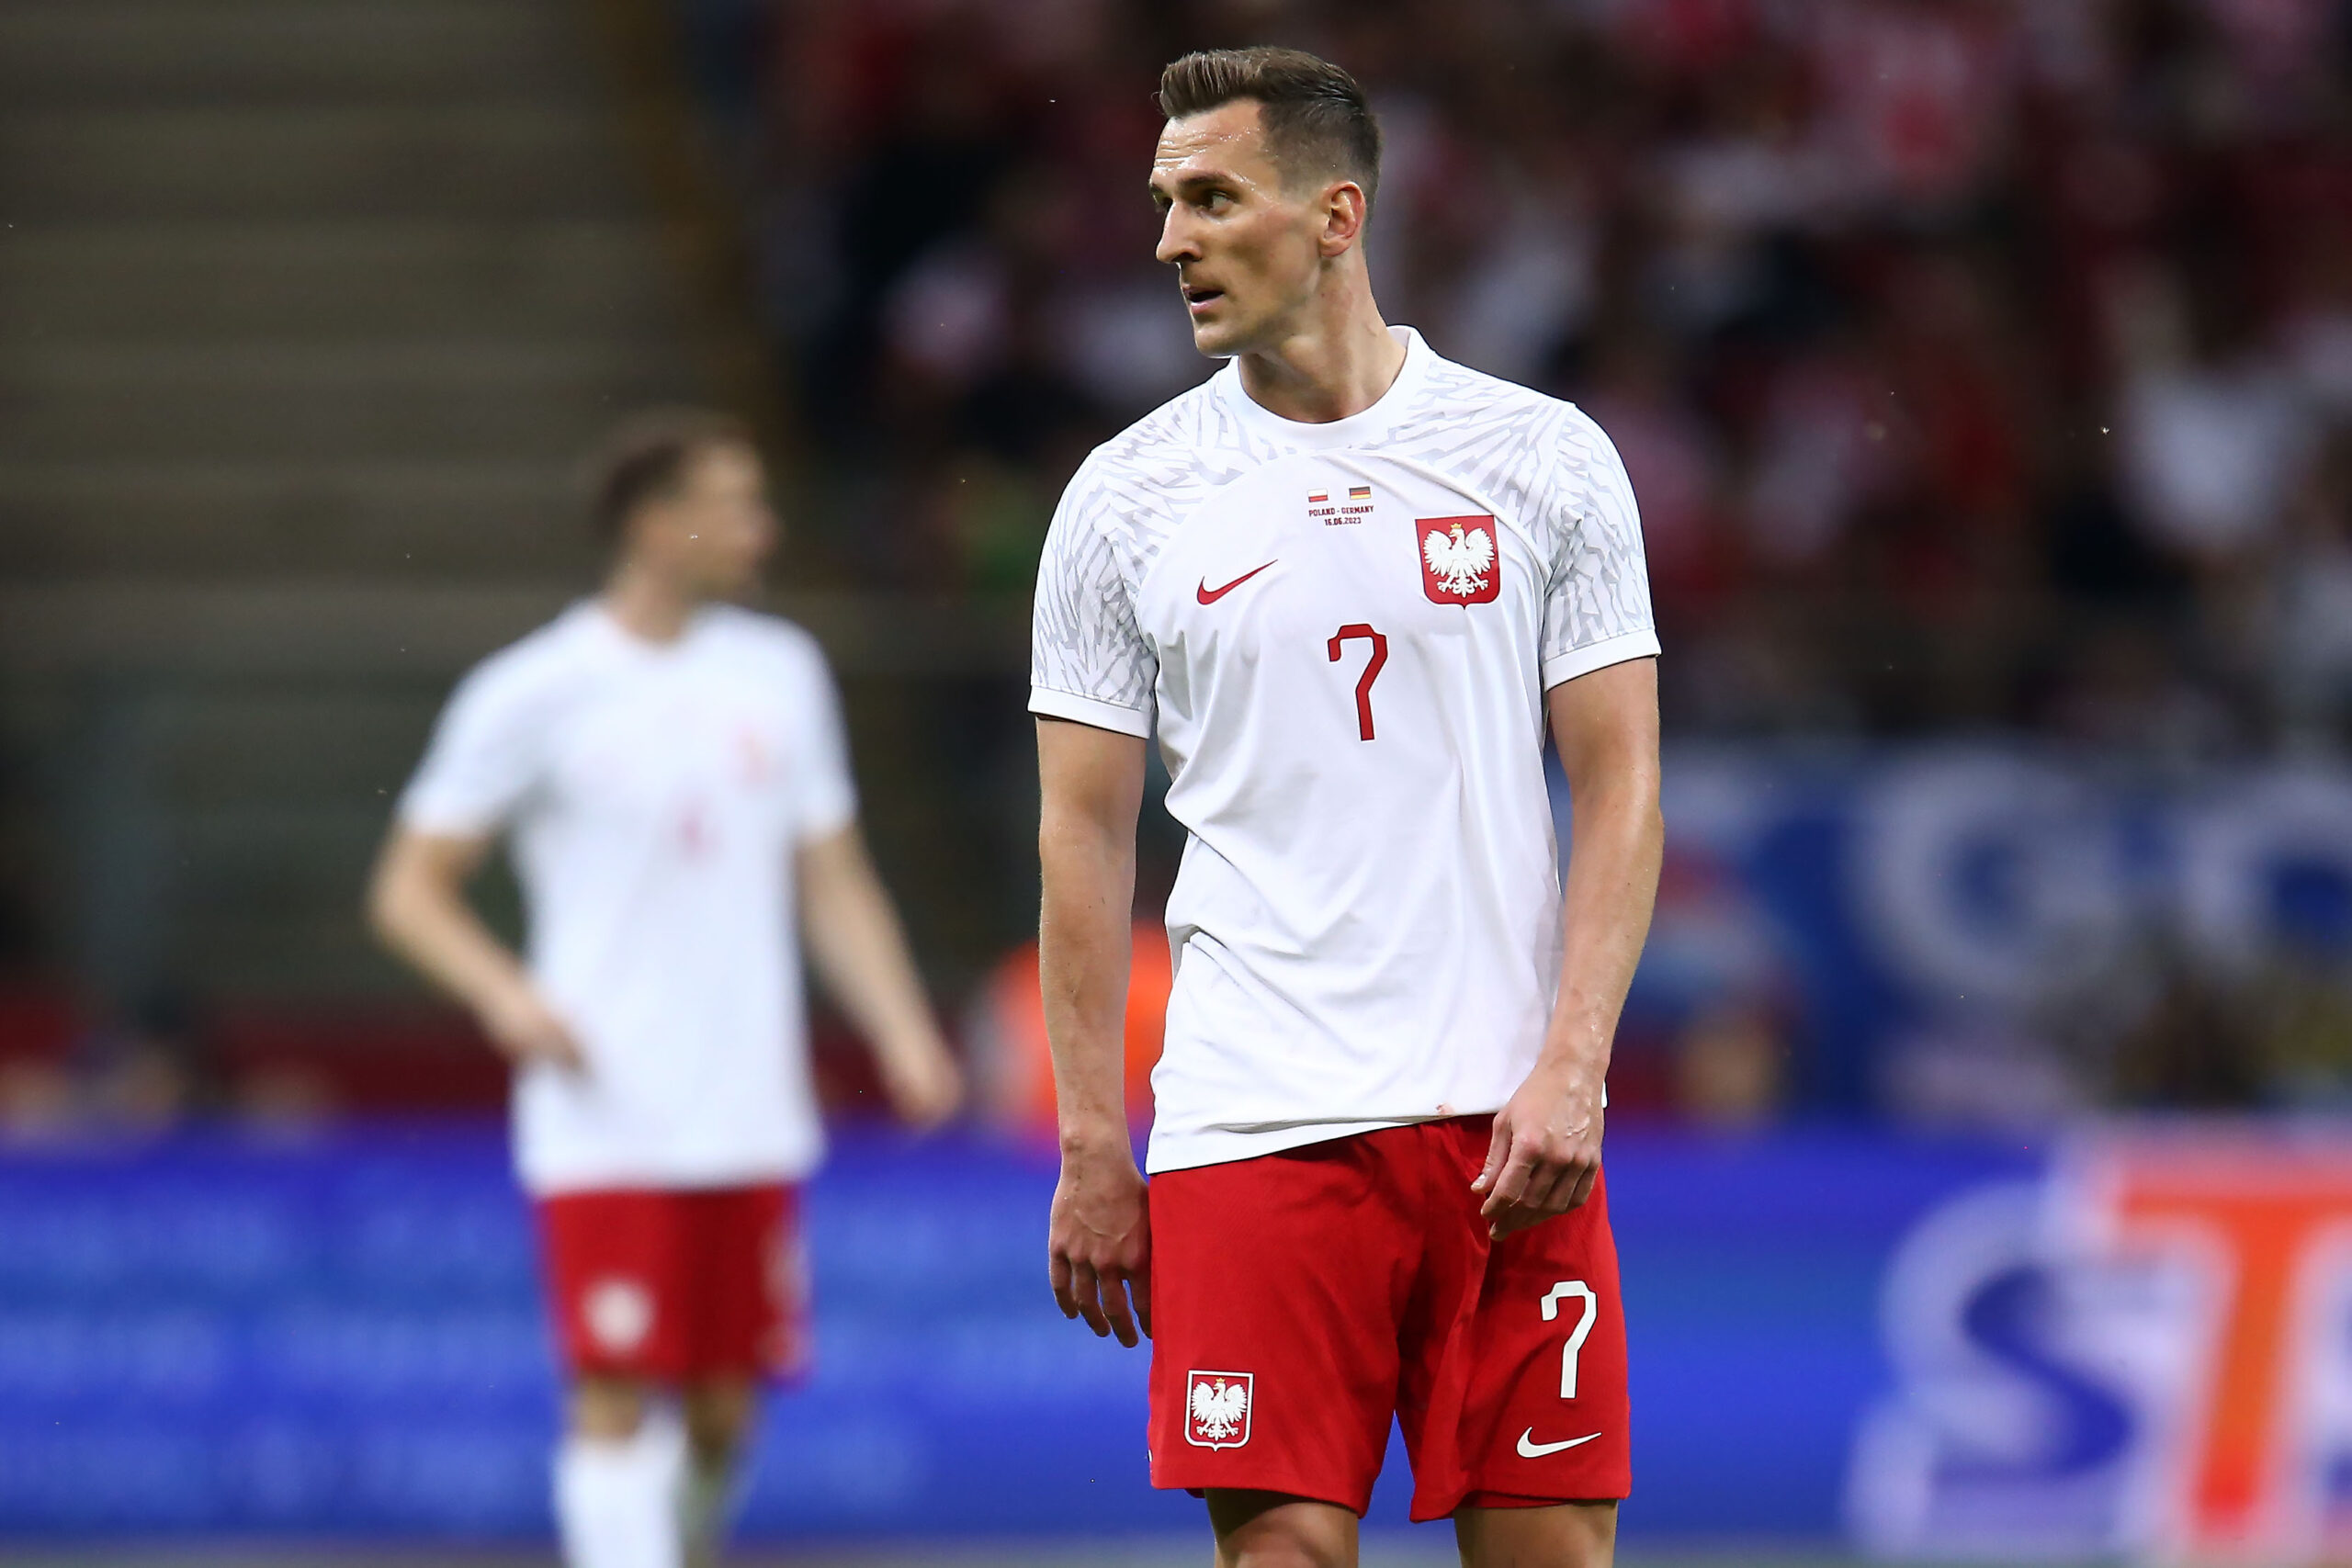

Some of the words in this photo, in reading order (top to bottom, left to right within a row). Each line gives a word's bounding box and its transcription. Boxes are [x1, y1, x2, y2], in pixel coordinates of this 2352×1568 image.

[1308, 507, 1336, 517] POLAND
[1340, 504, 1374, 514] GERMANY
[1324, 516, 1362, 525] 16.06.2023
[1327, 623, 1388, 741] 7
[1540, 1280, 1598, 1399] 7
[1929, 1162, 2352, 1534] ST
